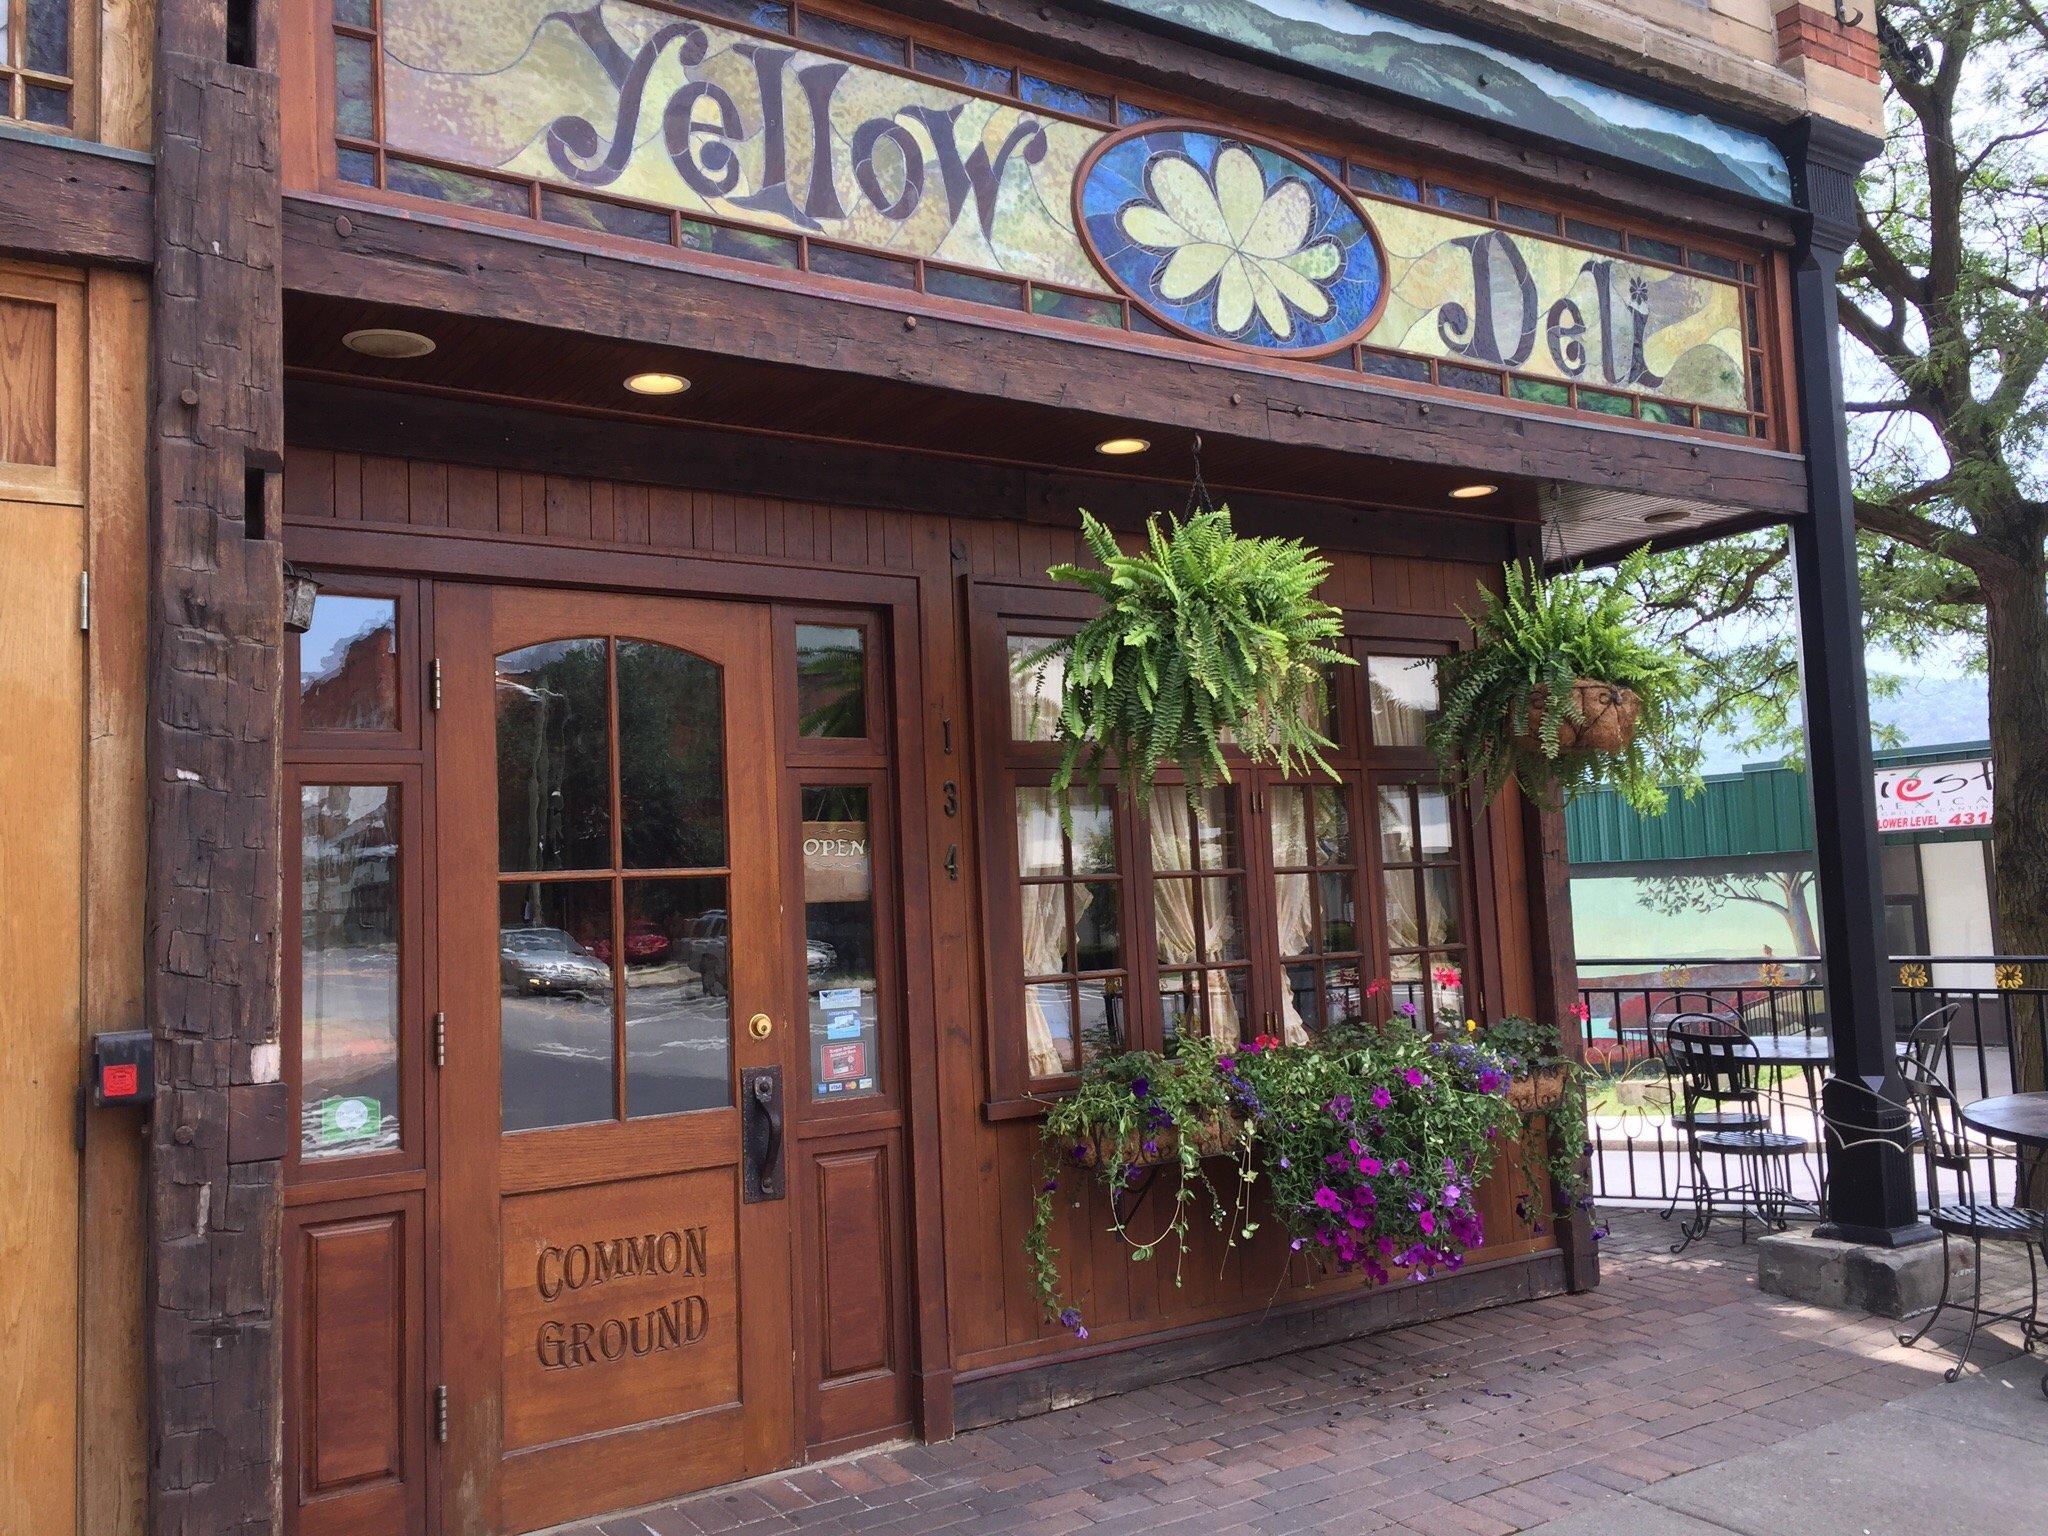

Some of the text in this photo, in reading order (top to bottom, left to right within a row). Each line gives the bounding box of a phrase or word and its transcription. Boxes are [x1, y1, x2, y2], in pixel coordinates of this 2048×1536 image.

[541, 4, 1665, 388] Yellow Deli
[803, 838, 866, 857] OPEN
[1877, 811, 1992, 829] LOWER LEVEL 431
[536, 1225, 709, 1303] COMMON
[536, 1295, 710, 1372] GROUND
